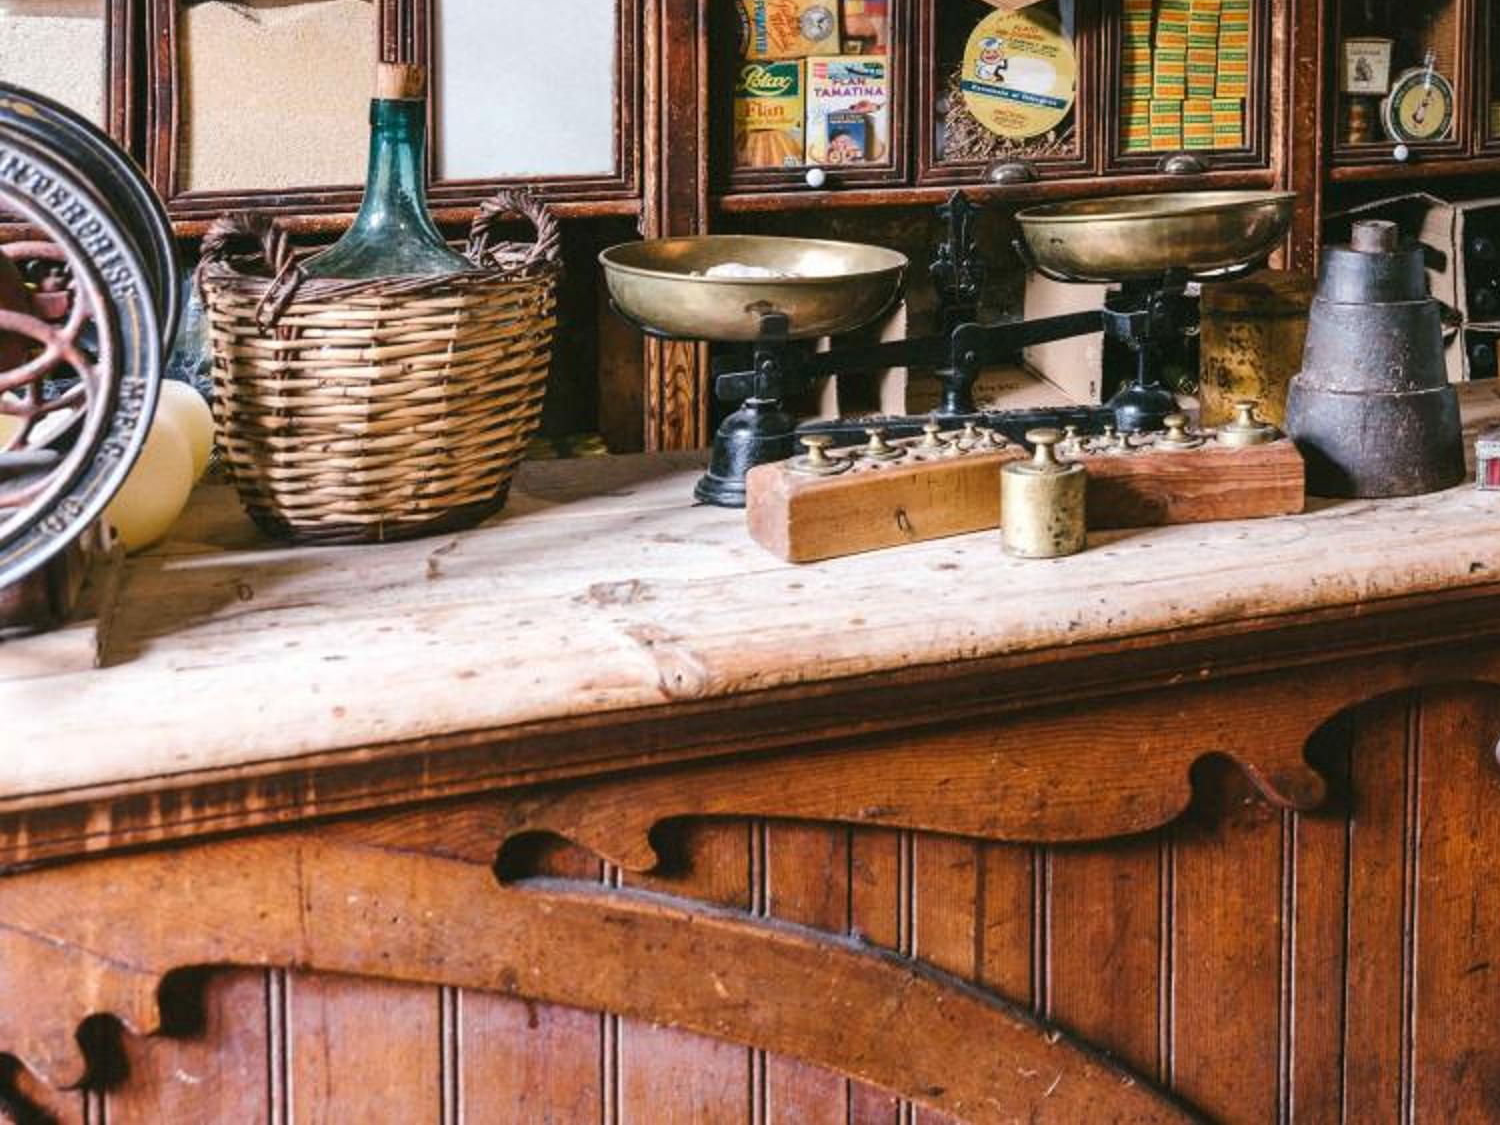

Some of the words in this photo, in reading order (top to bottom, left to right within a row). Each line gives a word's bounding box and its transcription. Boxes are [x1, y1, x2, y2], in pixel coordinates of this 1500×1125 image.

[831, 77, 866, 87] FLAN
[743, 100, 785, 117] Flan
[0, 151, 139, 300] NTERPRISE
